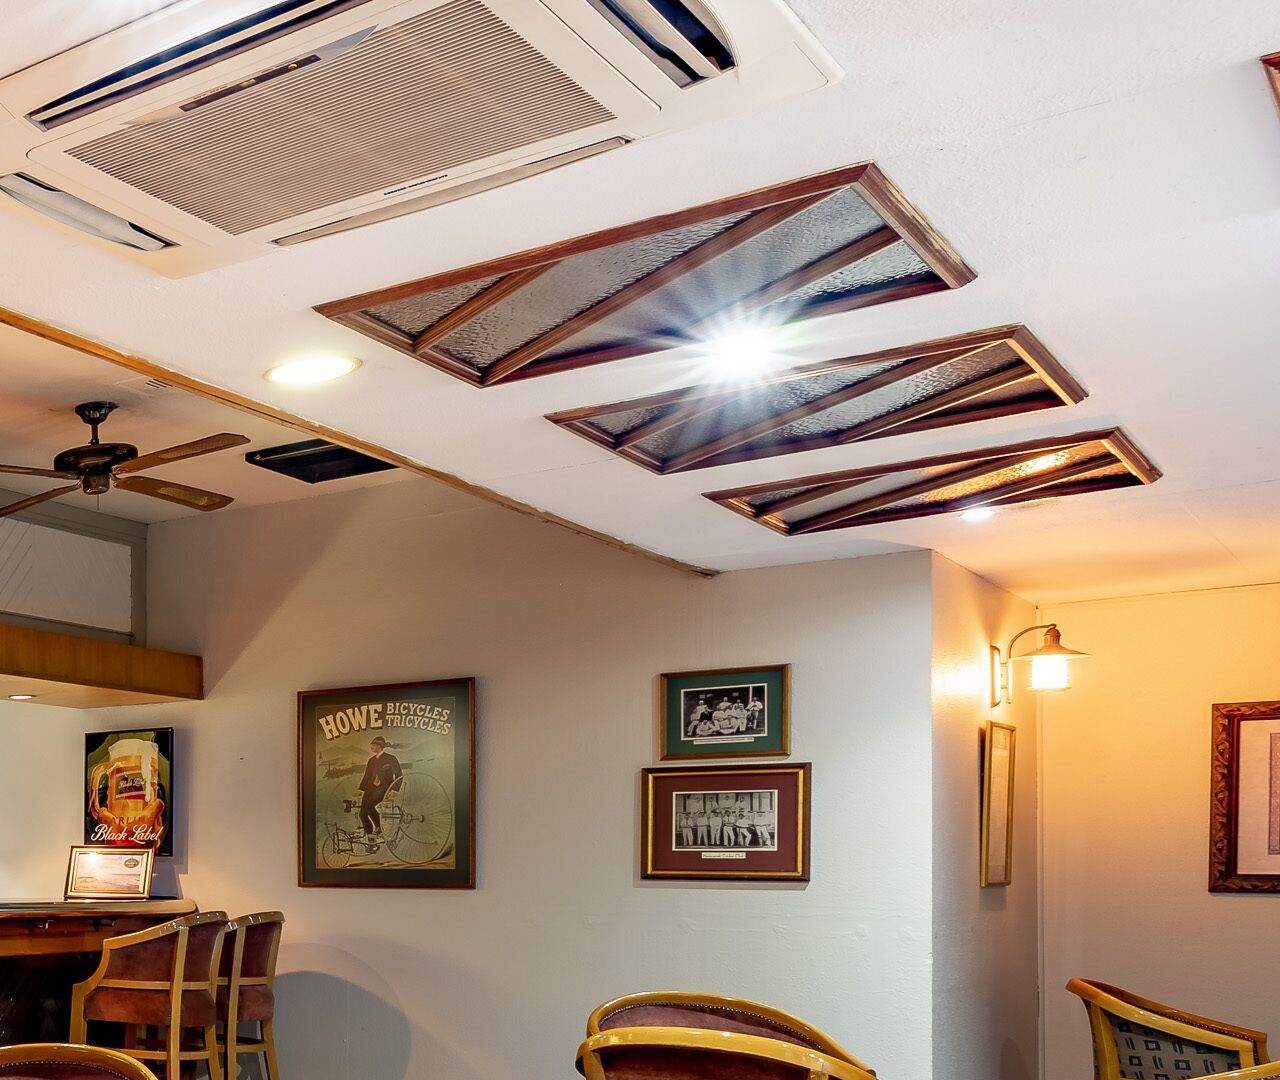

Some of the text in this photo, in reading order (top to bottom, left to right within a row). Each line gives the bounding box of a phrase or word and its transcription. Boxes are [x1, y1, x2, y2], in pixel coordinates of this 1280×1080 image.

[318, 703, 383, 741] HOWE
[385, 702, 451, 721] BICYCLES
[386, 714, 452, 736] TRICYCLES
[90, 823, 164, 845] Black Label
